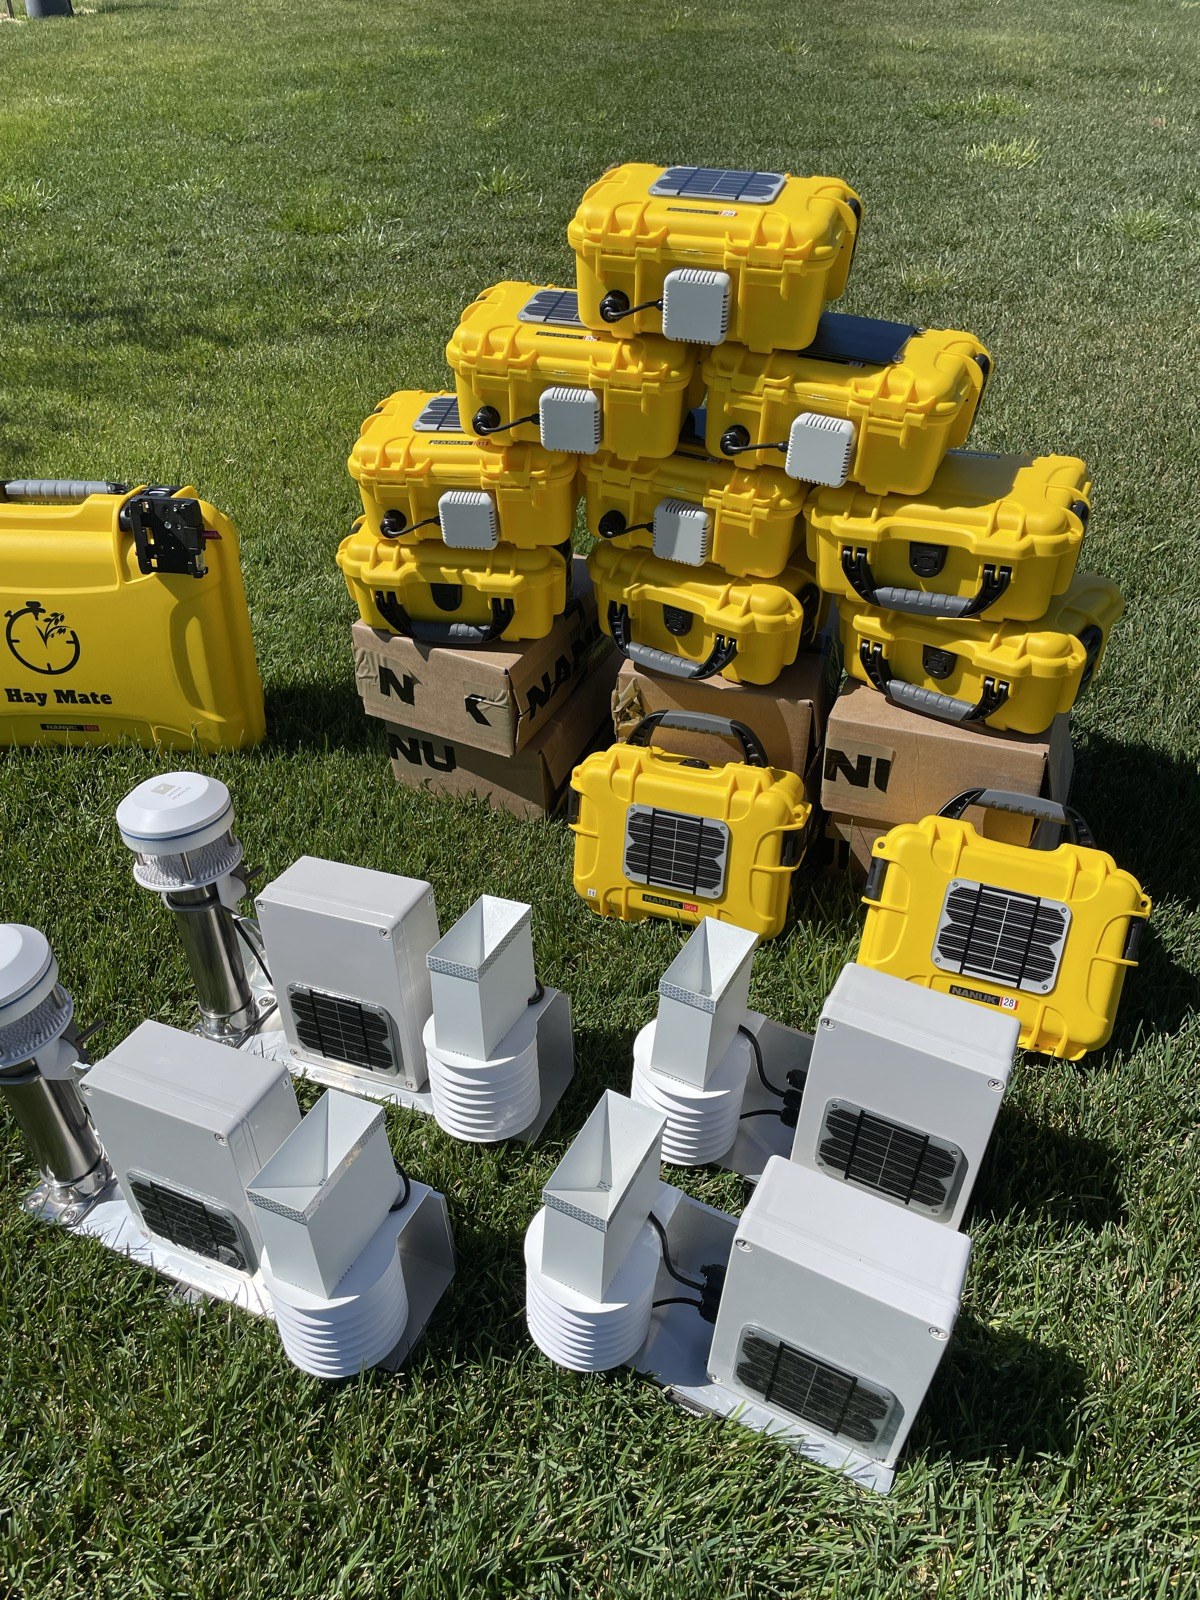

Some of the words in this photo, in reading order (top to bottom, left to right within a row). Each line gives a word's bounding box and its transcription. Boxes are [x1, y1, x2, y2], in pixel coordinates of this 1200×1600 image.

[5, 688, 48, 707] Hay
[53, 689, 113, 705] Mate
[643, 895, 681, 908] NANUK
[951, 986, 998, 1005] NANUK
[1003, 997, 1015, 1008] 28
